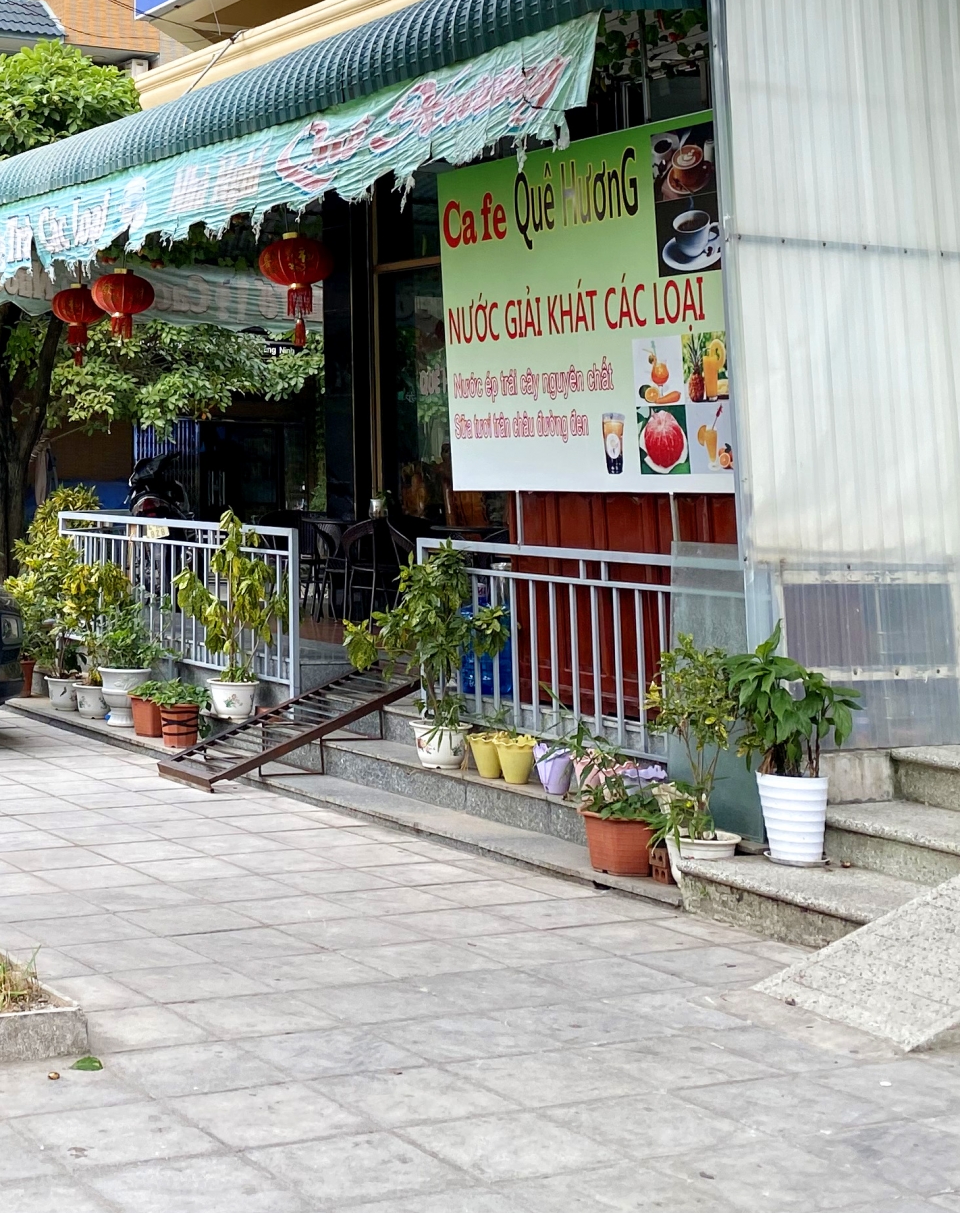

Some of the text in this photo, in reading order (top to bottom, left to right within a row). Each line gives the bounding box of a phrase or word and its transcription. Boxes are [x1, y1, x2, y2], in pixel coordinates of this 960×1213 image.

[514, 162, 555, 250] Quê
[448, 272, 705, 345] NƯỚC GIẢI KHÁT CÁC LOẠI
[453, 372, 483, 399] Nước
[484, 371, 498, 403] ép
[500, 368, 518, 396] trái
[520, 367, 540, 401] cây
[542, 364, 585, 400] nguyên
[587, 356, 615, 392] chất
[454, 409, 589, 444] Sữa tươi trân châu đường đen
